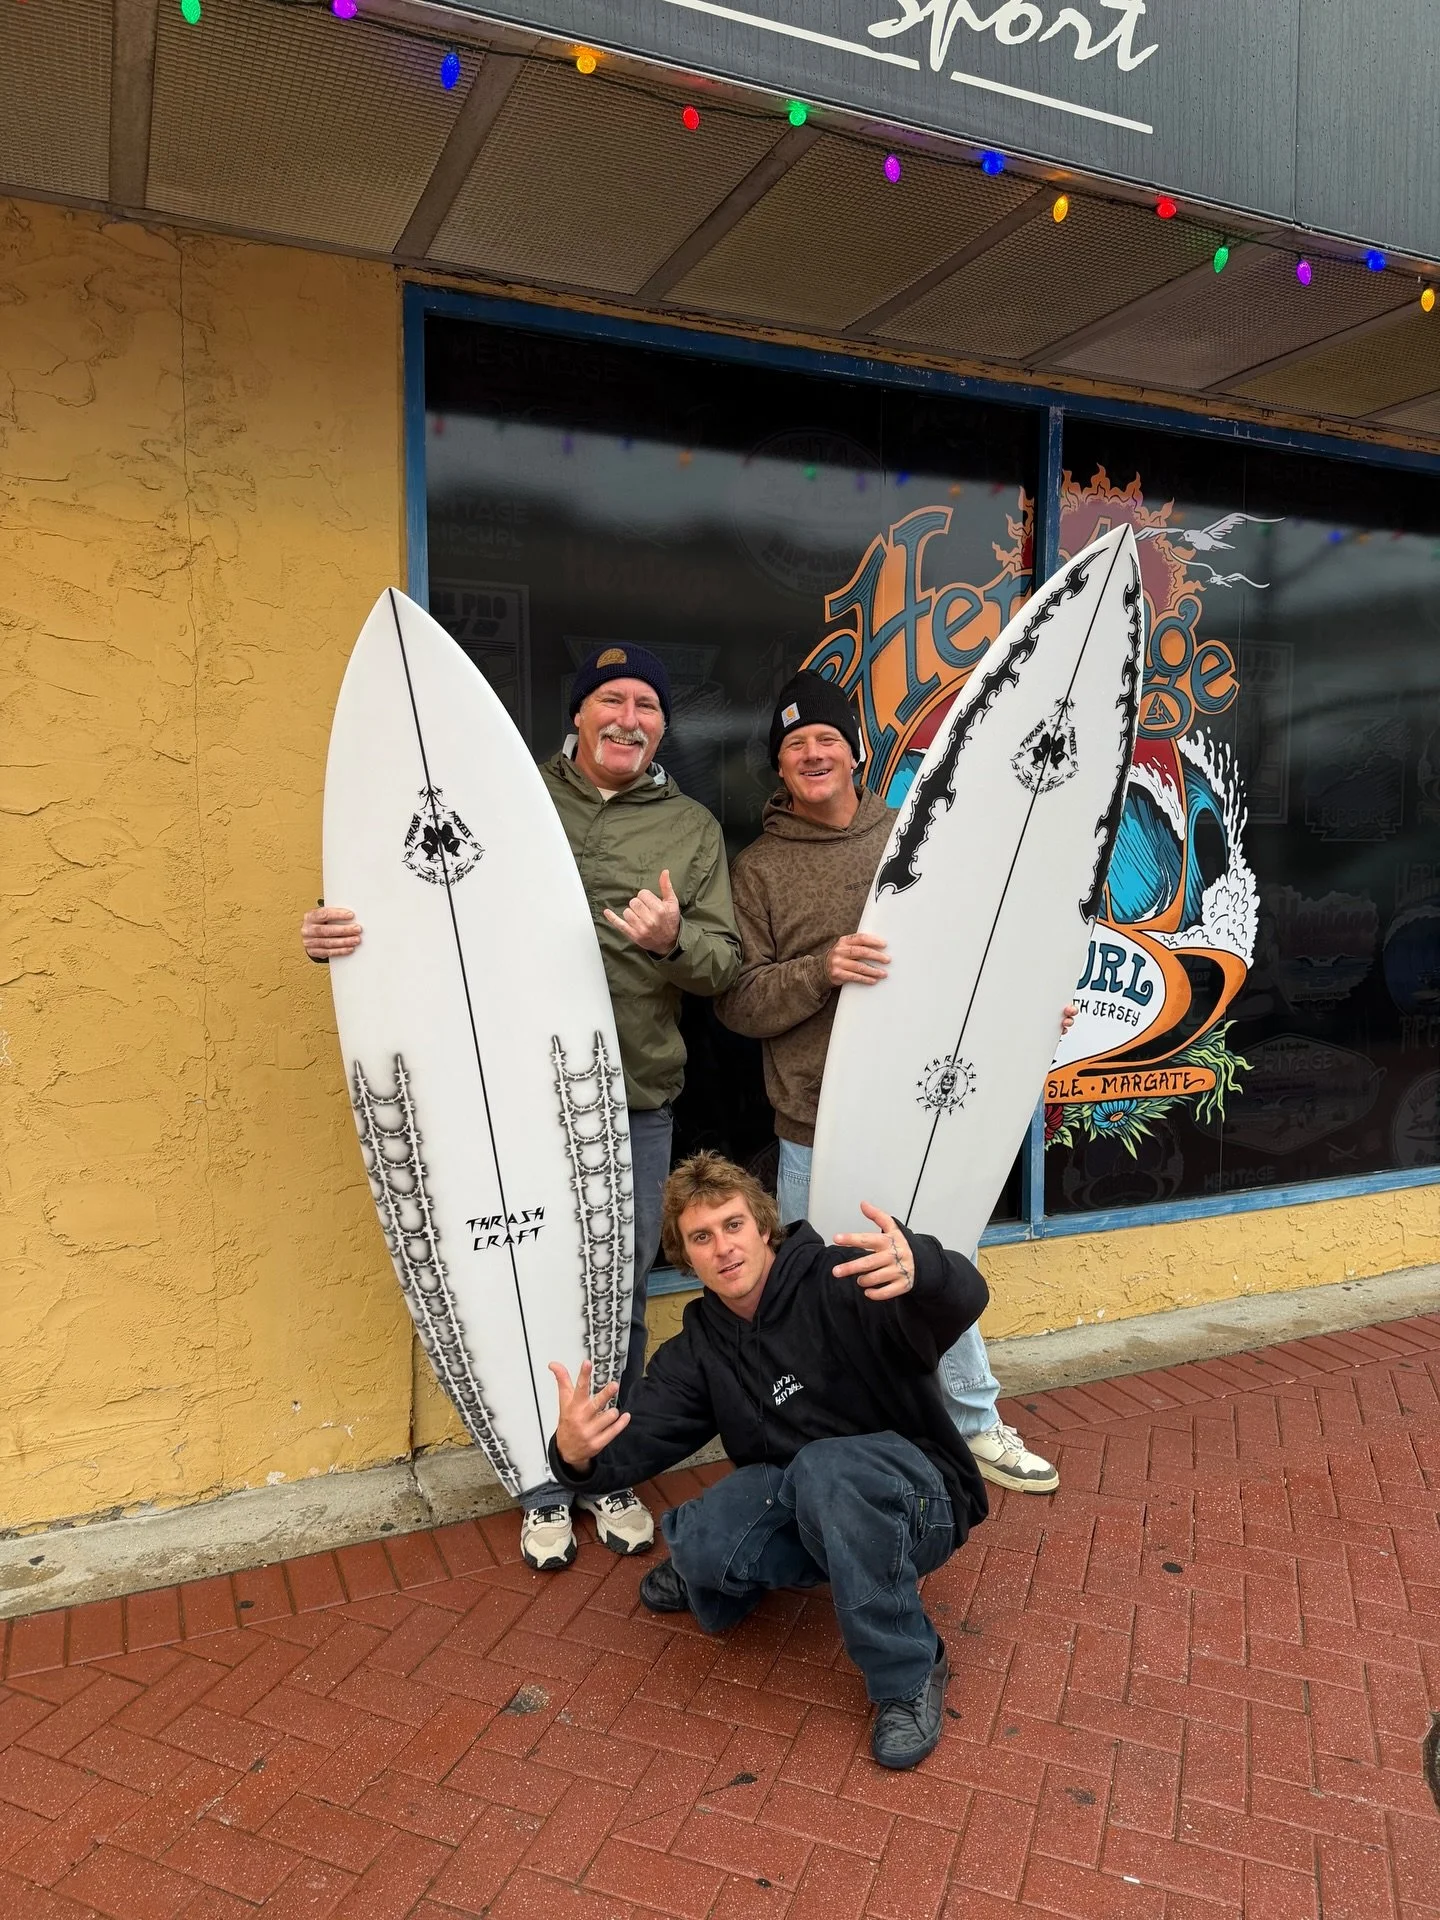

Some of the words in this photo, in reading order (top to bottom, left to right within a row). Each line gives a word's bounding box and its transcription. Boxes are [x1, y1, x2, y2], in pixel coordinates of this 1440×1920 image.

[1076, 940, 1154, 1007] URL
[1092, 1000, 1141, 1027] JERSEY
[1047, 1078, 1084, 1099] SLE
[1101, 1071, 1206, 1095] MARGATE
[465, 1206, 546, 1234] THRASH
[473, 1224, 547, 1251] CRAFT
